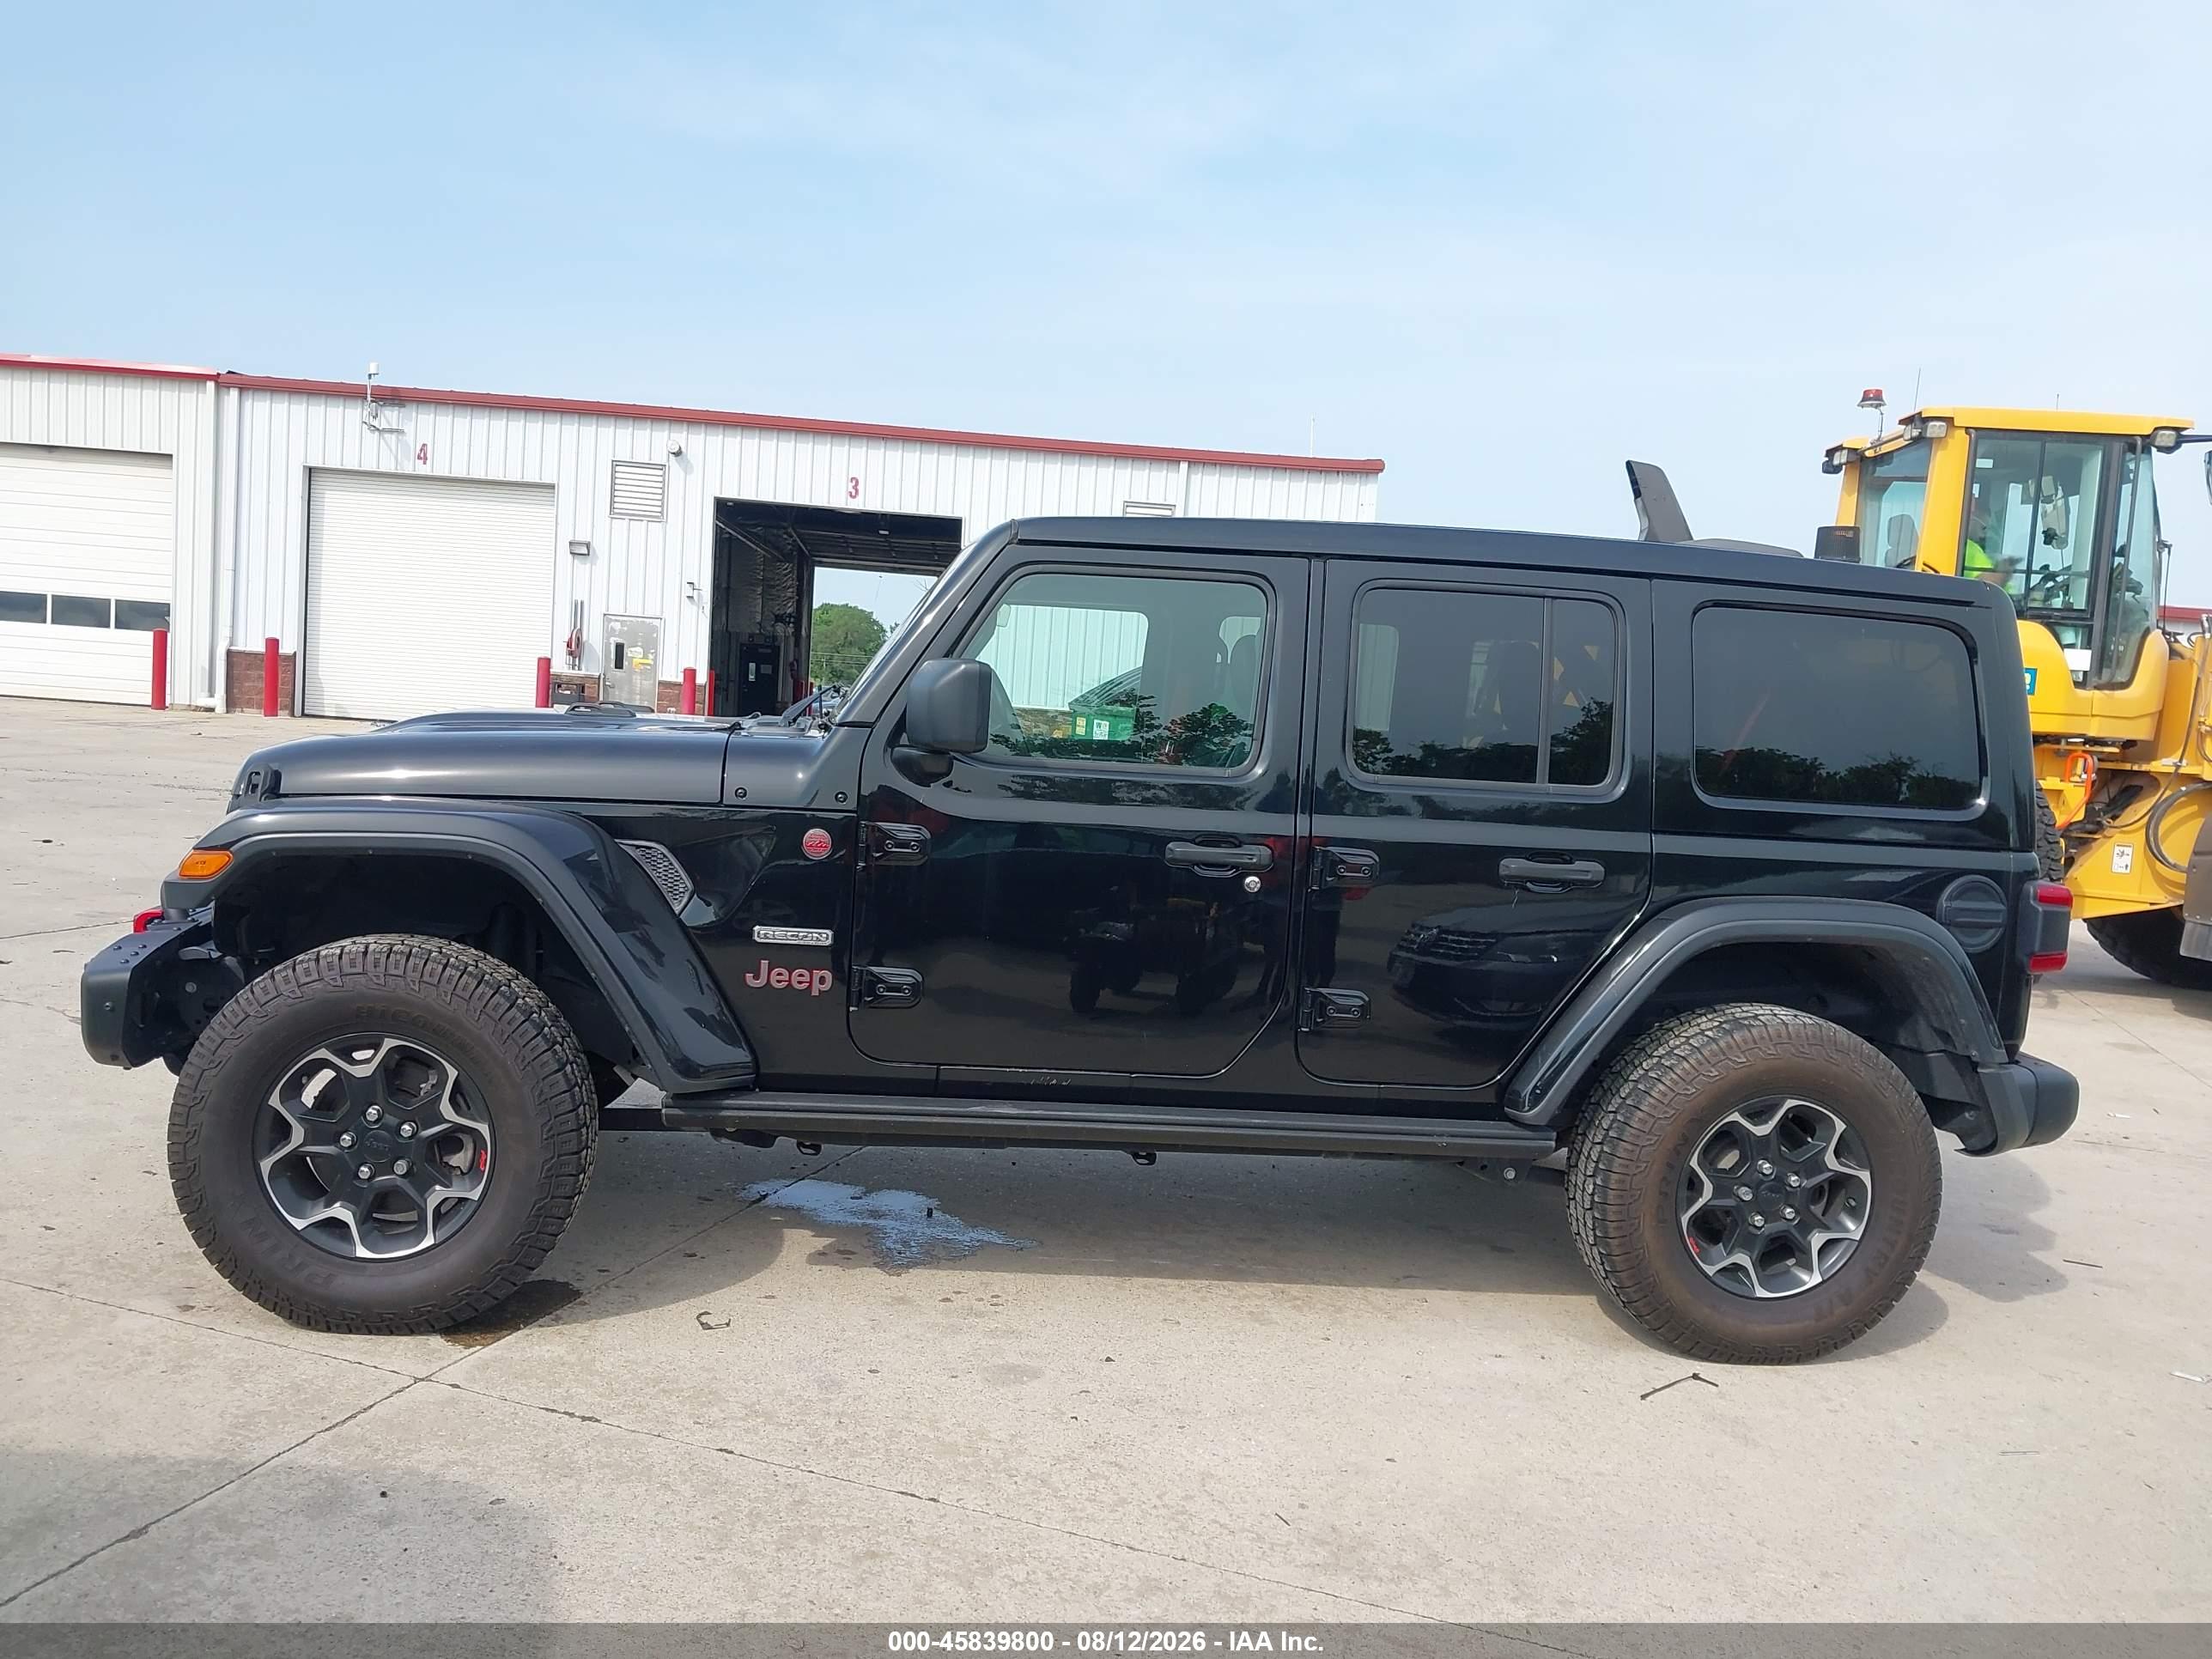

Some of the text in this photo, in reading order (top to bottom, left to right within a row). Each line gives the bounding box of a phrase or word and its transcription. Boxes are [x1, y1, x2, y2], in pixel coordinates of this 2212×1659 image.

[416, 442, 428, 465] 4
[848, 477, 860, 500] 3
[744, 959, 833, 996] Jeep
